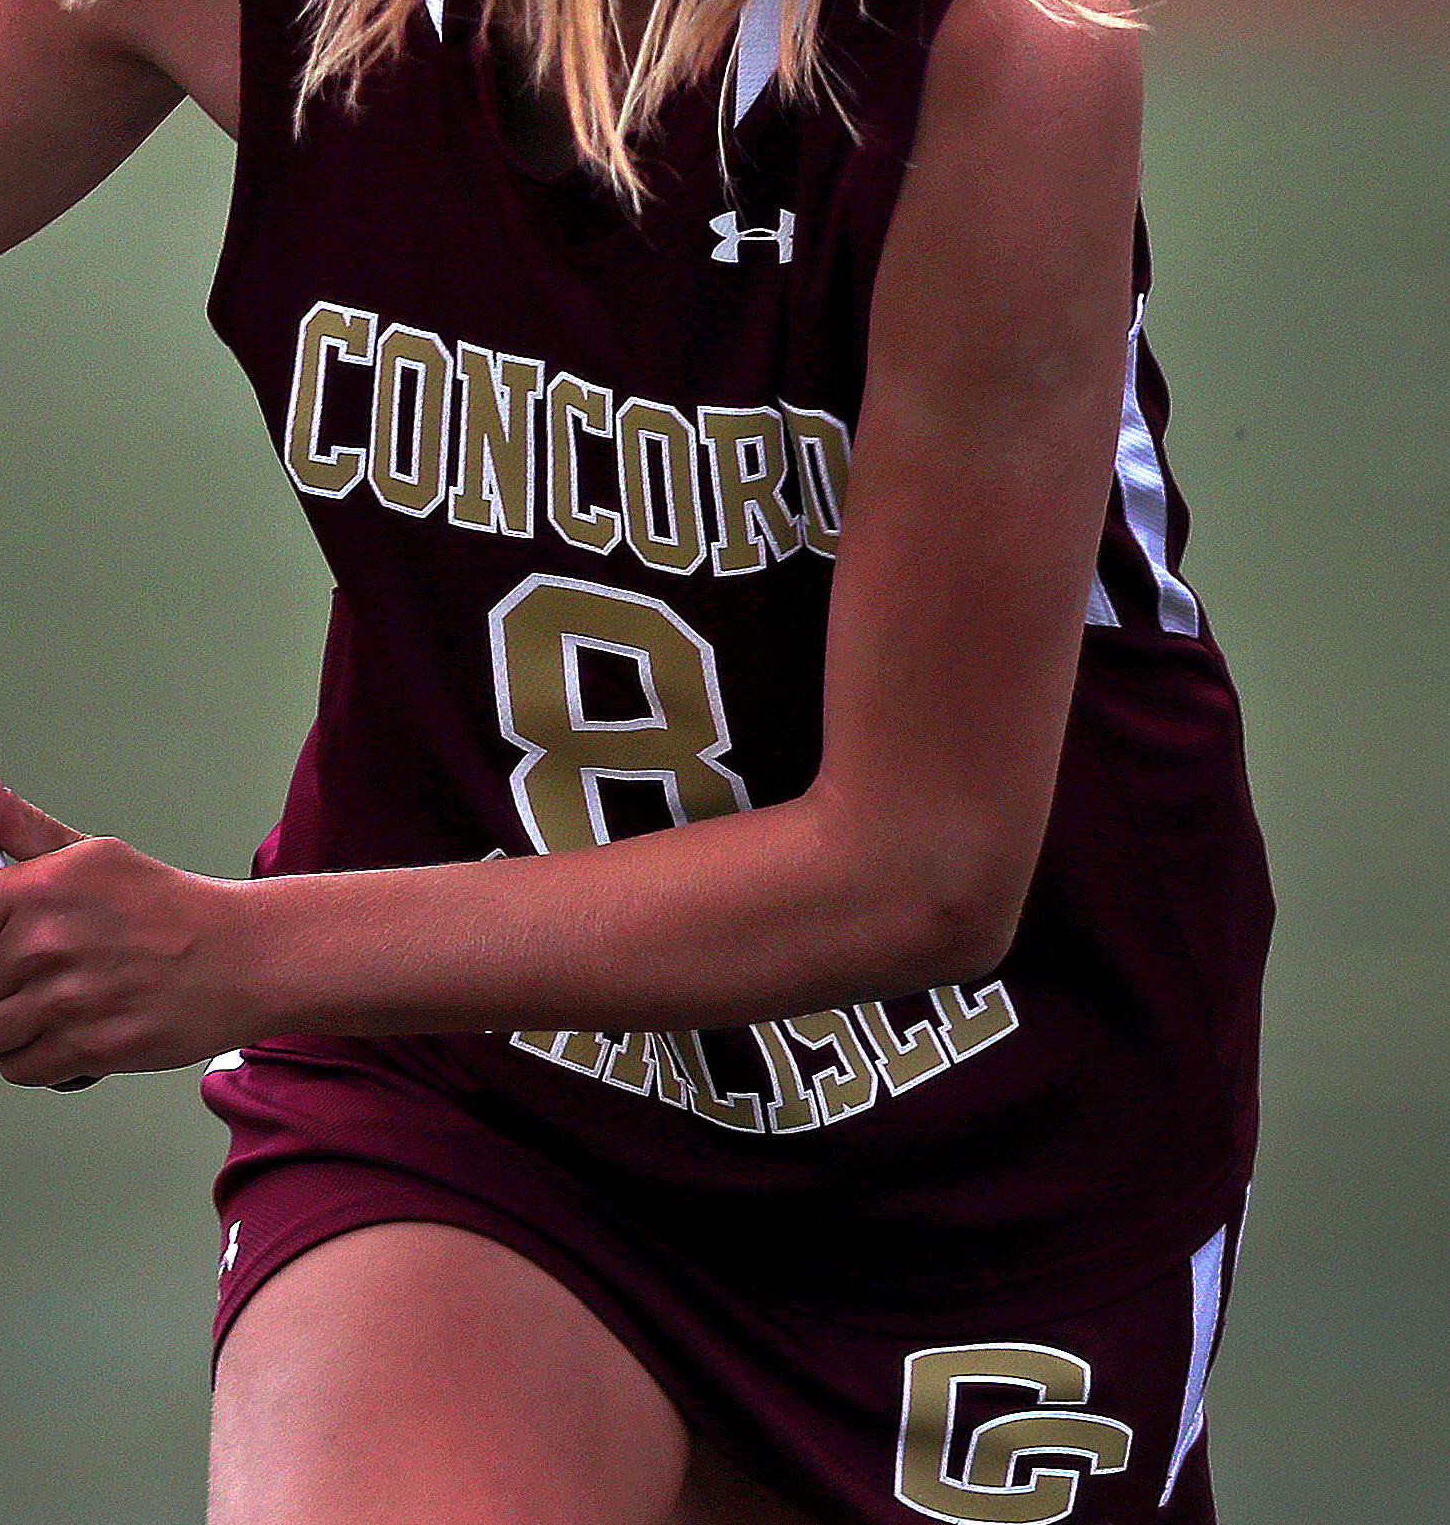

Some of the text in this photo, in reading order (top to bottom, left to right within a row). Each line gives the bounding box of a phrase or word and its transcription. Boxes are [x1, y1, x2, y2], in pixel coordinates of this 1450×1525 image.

[284, 301, 851, 576] CONCORD
[488, 572, 752, 856] 8
[507, 978, 1021, 1135] LISL
